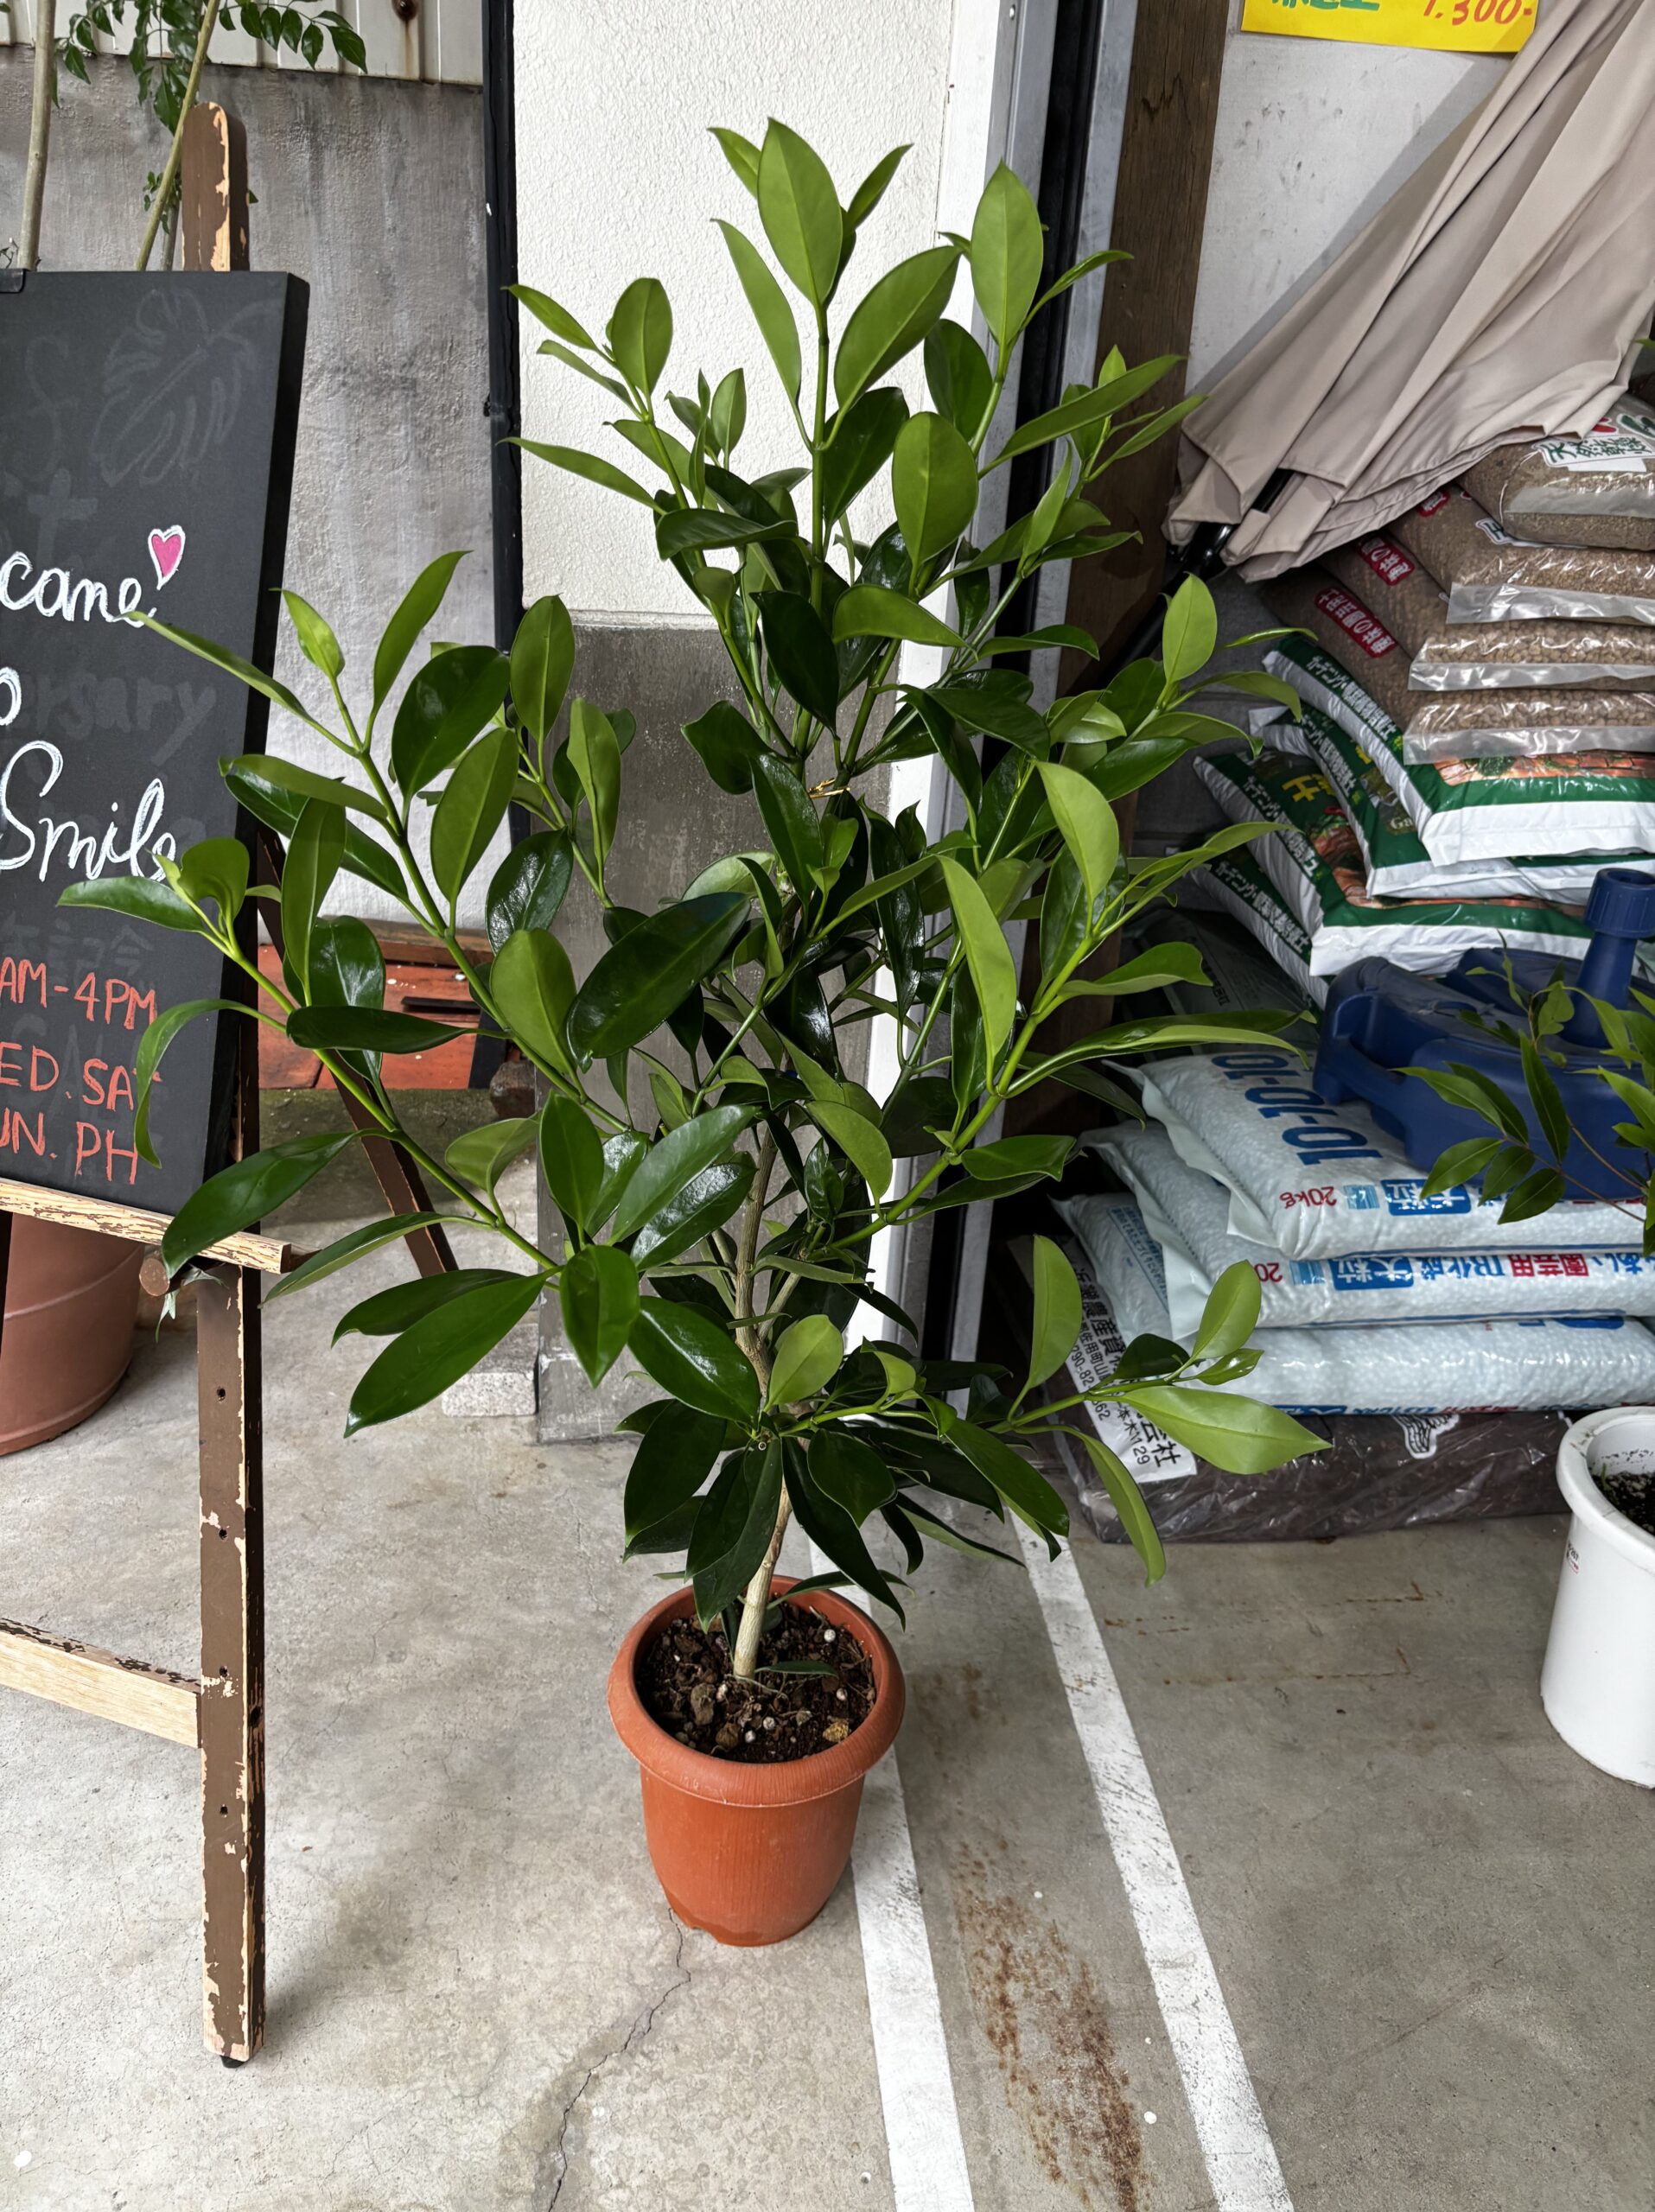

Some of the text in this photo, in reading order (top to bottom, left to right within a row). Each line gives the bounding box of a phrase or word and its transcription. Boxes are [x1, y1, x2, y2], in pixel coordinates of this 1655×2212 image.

[1295, 714, 1356, 798] デニング・観葉植物培養土
[75, 1121, 138, 1185] PH
[1279, 1185, 1339, 1210] 20kg
